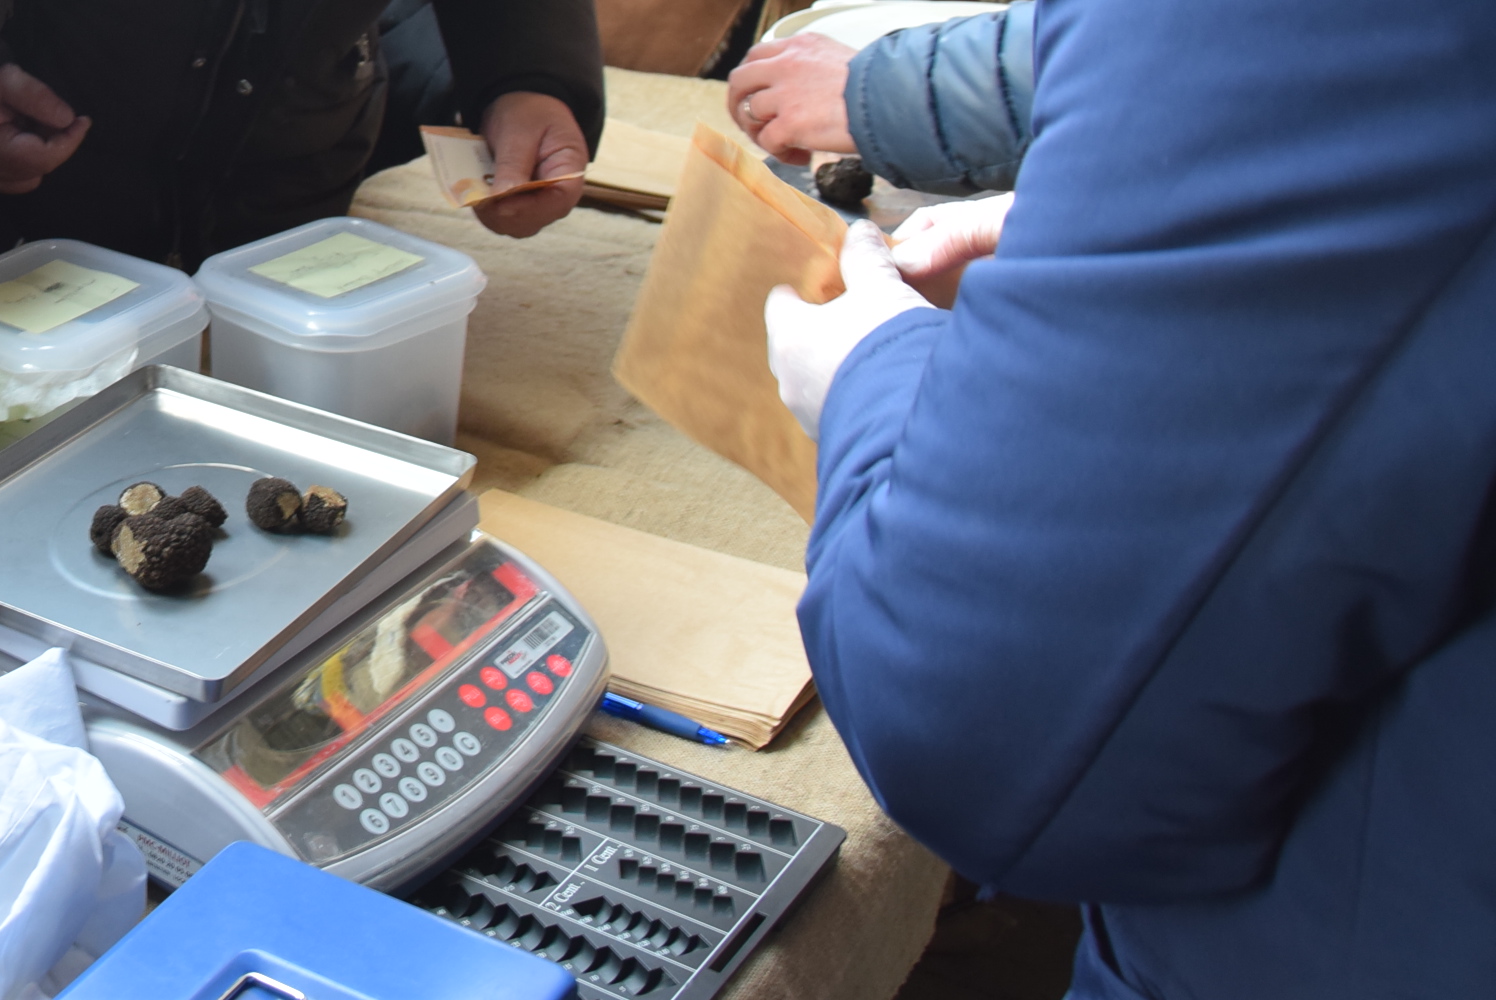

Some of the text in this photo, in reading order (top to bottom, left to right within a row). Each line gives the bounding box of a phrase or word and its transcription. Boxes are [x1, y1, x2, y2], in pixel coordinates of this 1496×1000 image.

[341, 728, 431, 803] 1 2 3 4 5
[368, 736, 475, 829] 6 7 8 9 0 C
